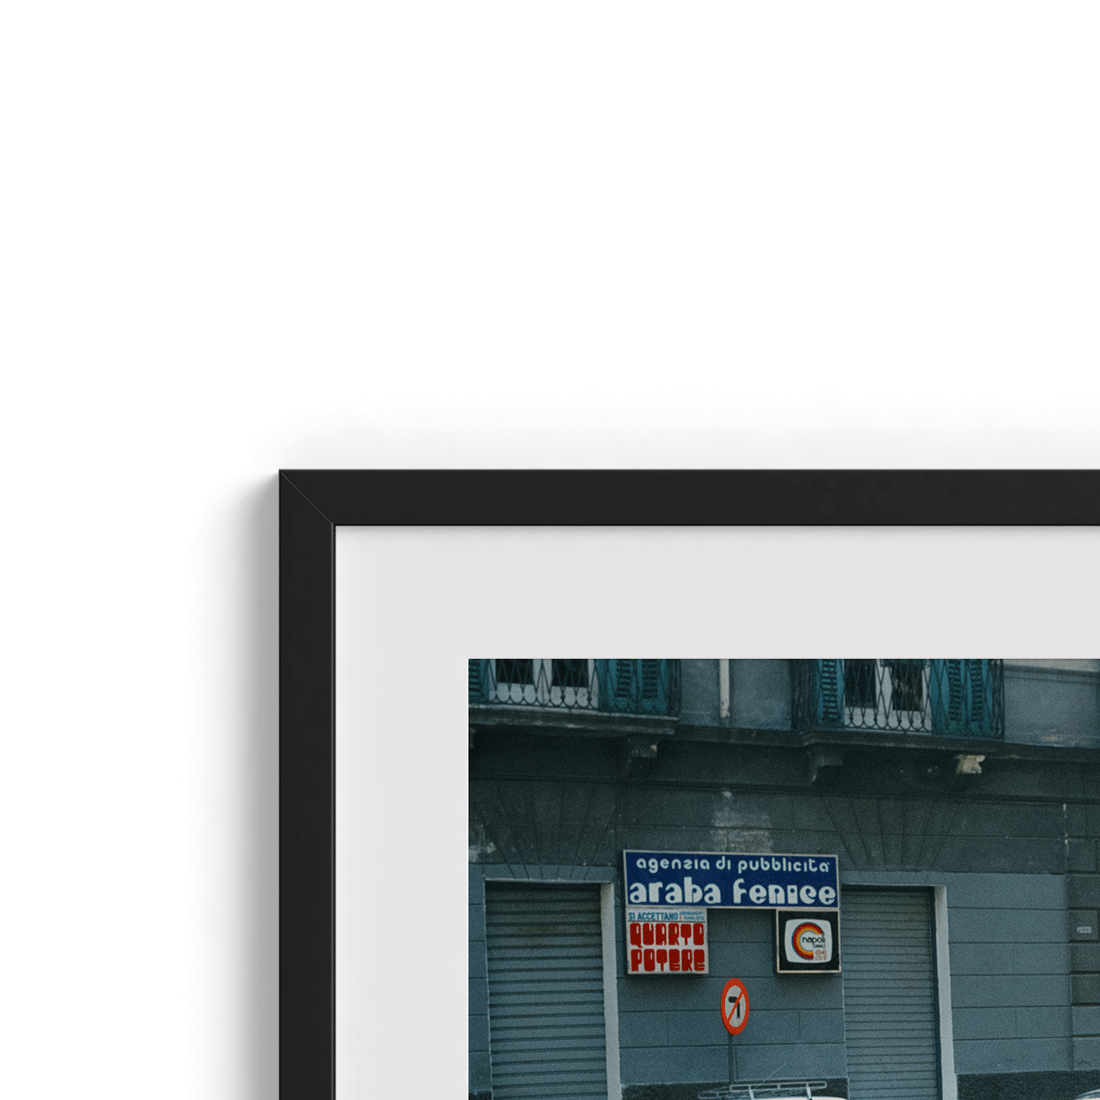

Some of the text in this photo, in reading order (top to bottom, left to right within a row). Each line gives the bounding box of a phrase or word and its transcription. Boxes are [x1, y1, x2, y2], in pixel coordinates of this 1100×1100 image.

[636, 858, 710, 874] agenzia
[716, 856, 731, 870] di
[629, 876, 836, 905] araba fenice
[628, 912, 636, 920] SI
[630, 922, 705, 948] QUARTO
[631, 949, 706, 972] POTERE
